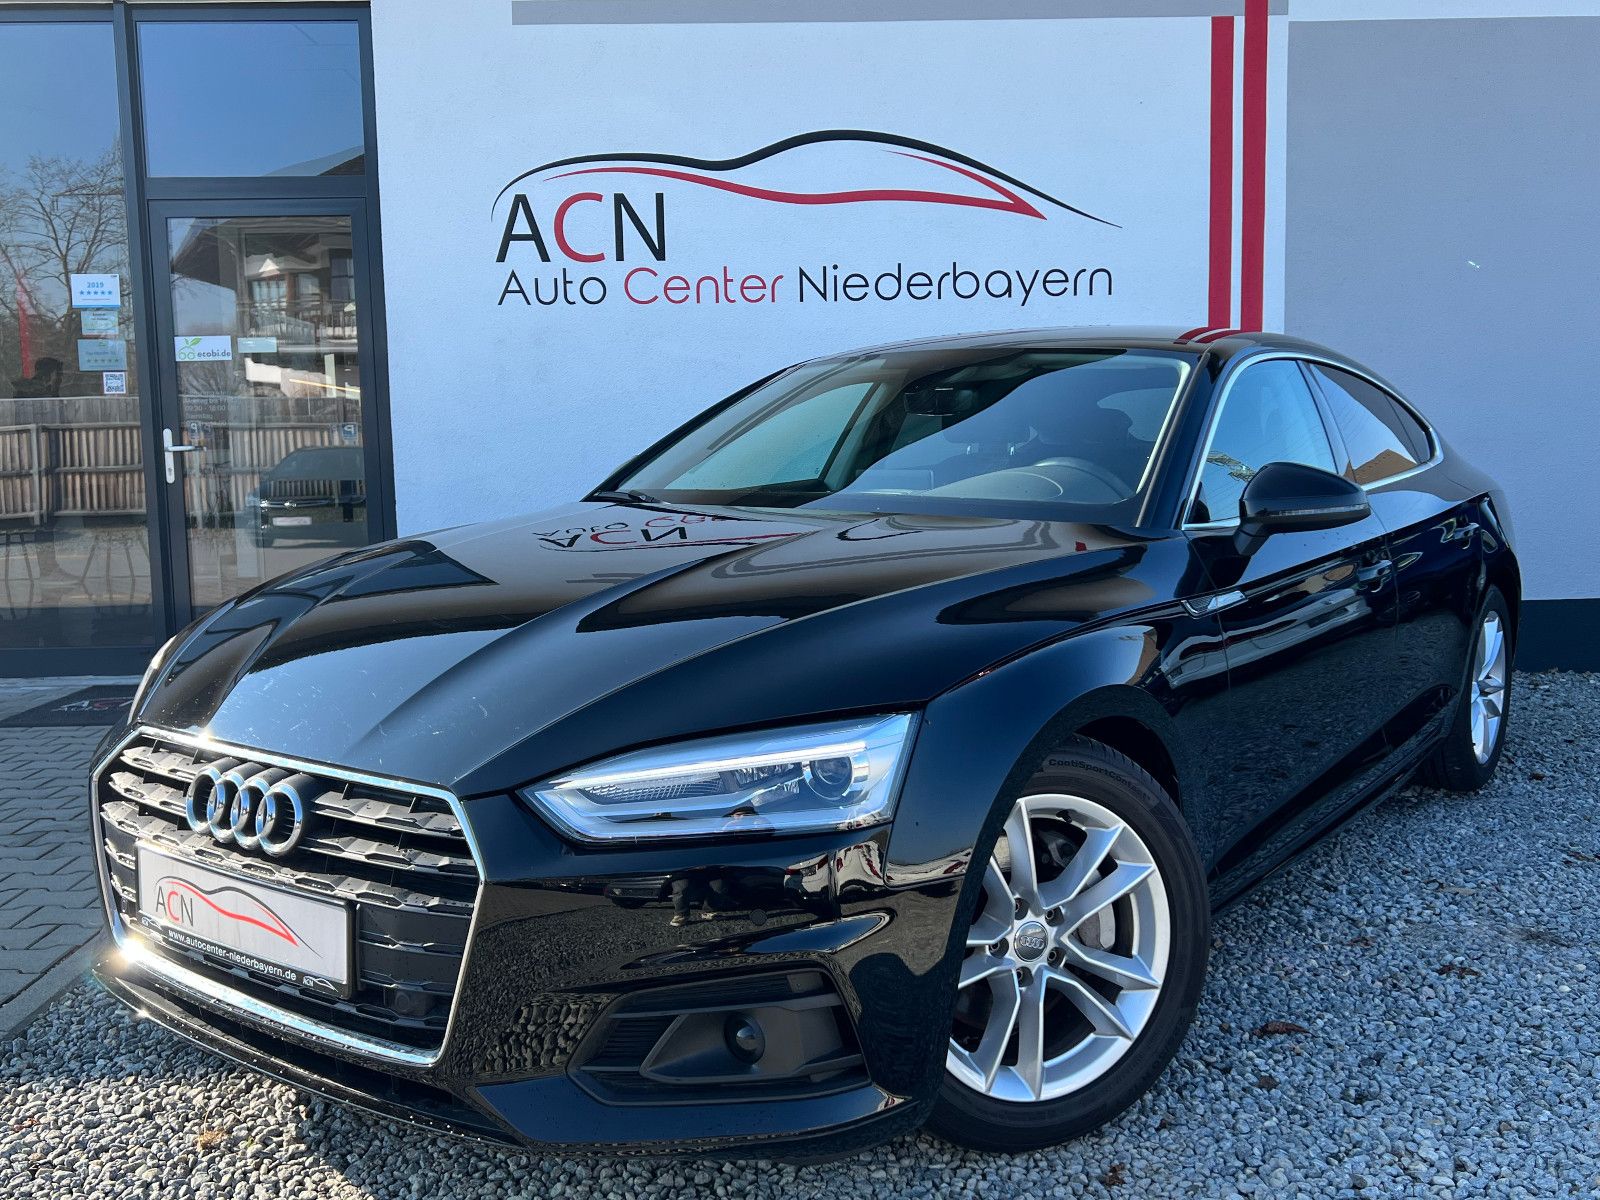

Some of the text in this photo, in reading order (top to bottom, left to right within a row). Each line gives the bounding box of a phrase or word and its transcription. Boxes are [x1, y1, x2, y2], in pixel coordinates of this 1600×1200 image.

[495, 192, 666, 263] ACN
[497, 261, 1113, 308] Auto Center Niederbayern
[197, 348, 231, 358] ecobi.de
[155, 885, 194, 927] ACN
[168, 929, 297, 981] www.autocenter-niederbayern.de
